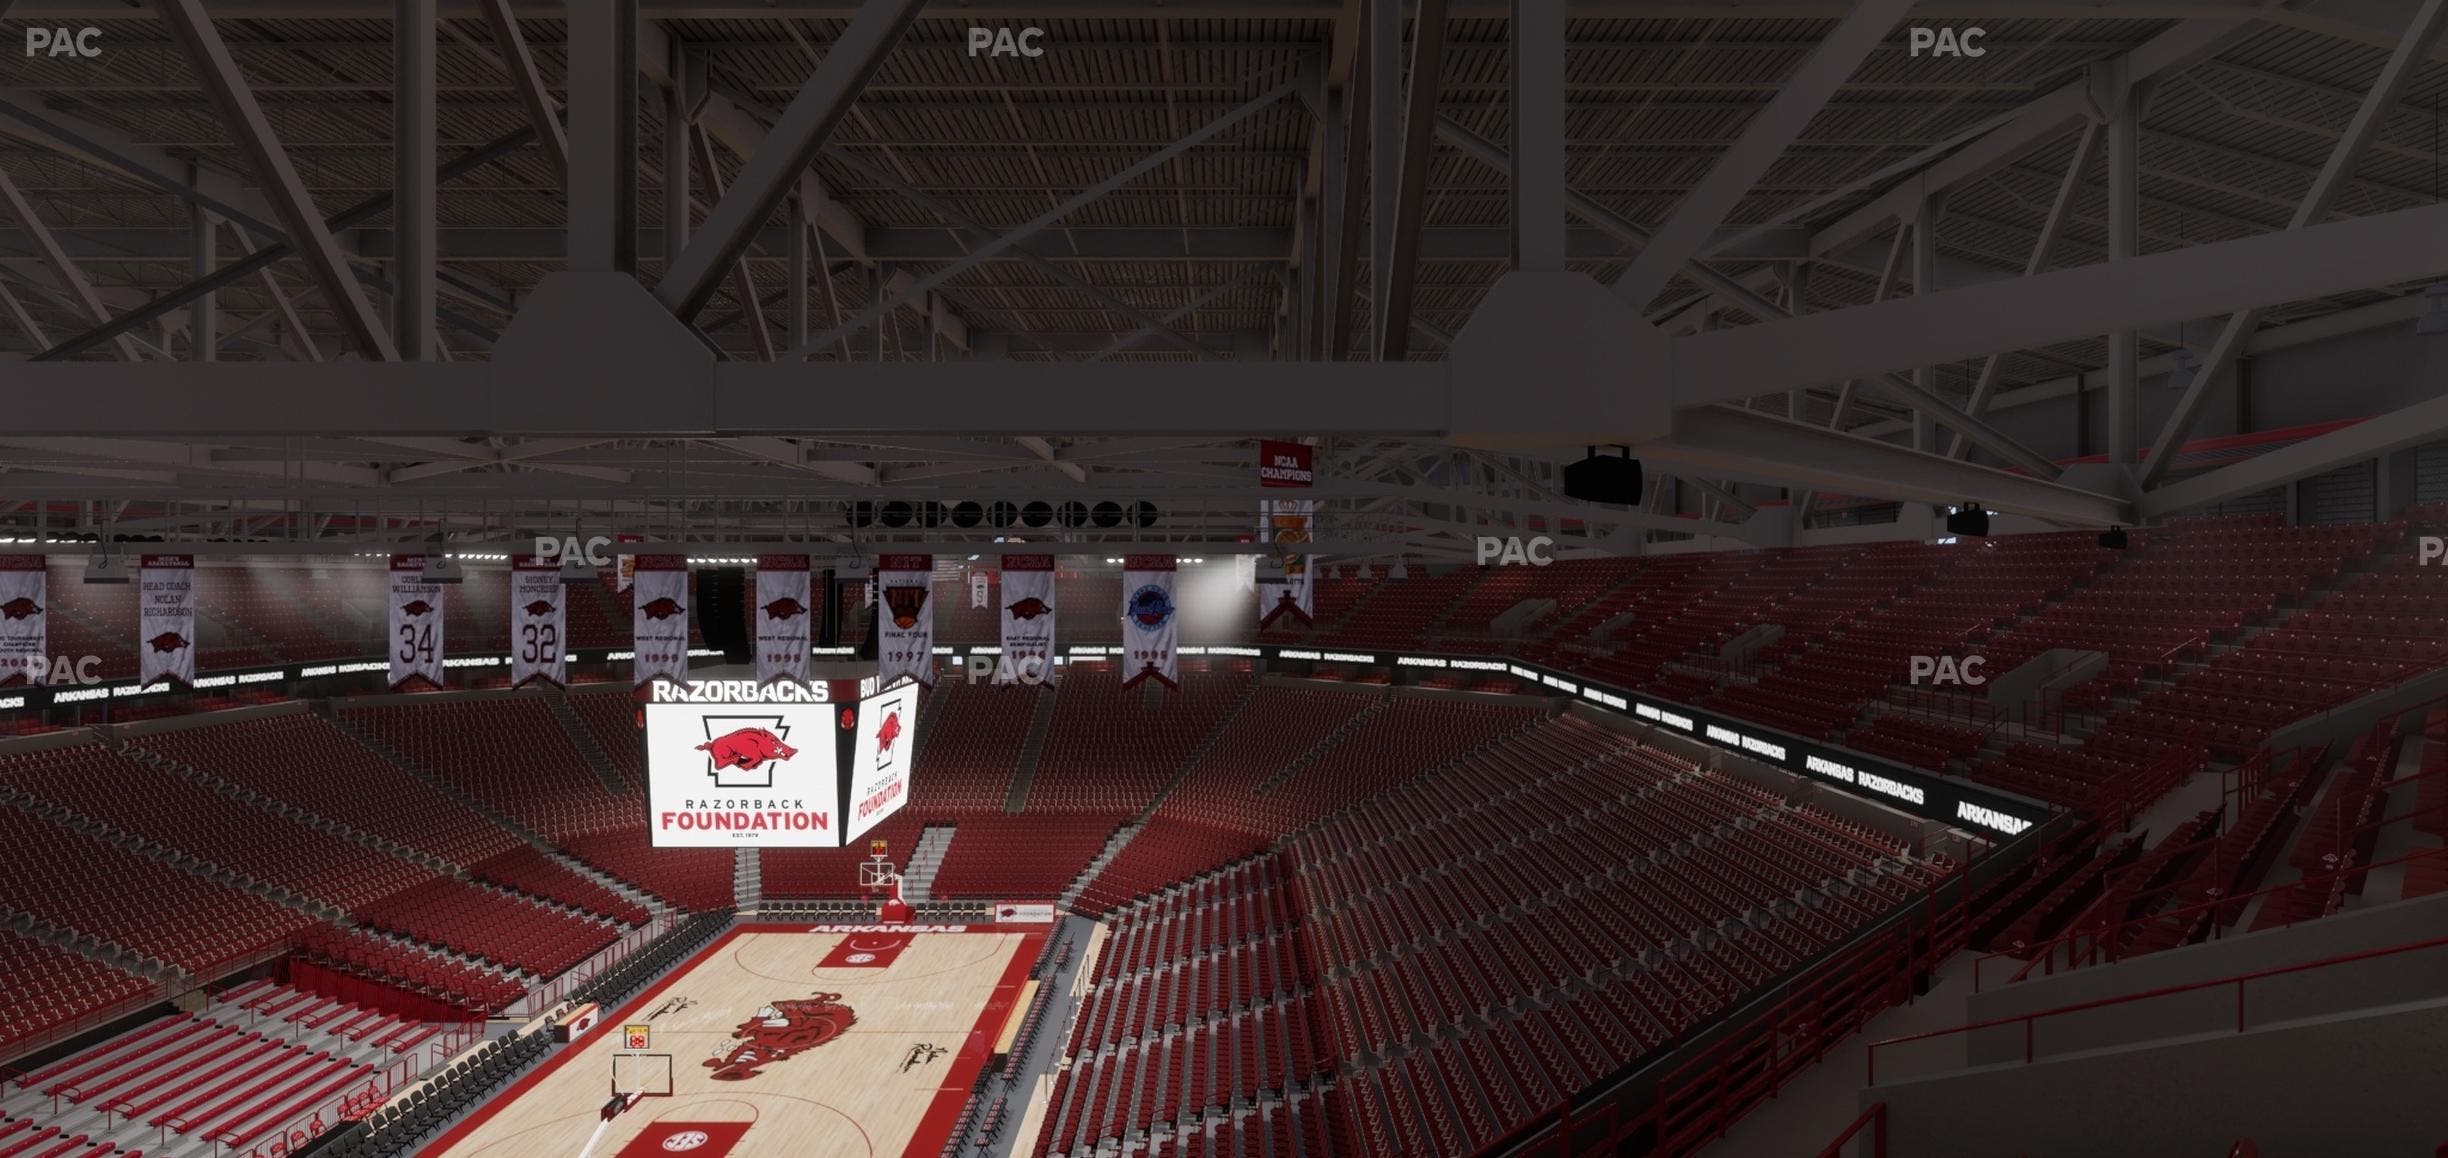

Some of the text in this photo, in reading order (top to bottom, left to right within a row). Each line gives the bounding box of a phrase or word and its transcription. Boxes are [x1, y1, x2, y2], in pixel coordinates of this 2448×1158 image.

[1273, 455, 1299, 468] NCAA
[1261, 467, 1312, 482] CHAMPIONS
[143, 582, 191, 591] HEAD COACH
[392, 585, 441, 593] WILLIAMSON
[154, 595, 182, 604] NOLAN
[144, 607, 192, 617] RICHARDSON
[400, 624, 434, 663] 34
[522, 624, 556, 663] 32
[443, 657, 500, 667] RKANSAS
[888, 652, 924, 662] 1997
[1397, 656, 1447, 668] ARKANSAS
[194, 675, 236, 688] ARKANSAS
[54, 688, 109, 704] ARKANSAS
[652, 680, 829, 702] RAZORBACKS
[1805, 755, 1924, 805] ARKANSAS RAZORBACKS
[686, 799, 804, 809] RAZORBACK
[857, 778, 903, 821] FOUNDATION
[661, 812, 828, 830] FOUNDATION
[808, 925, 968, 933] ARKANSAS
